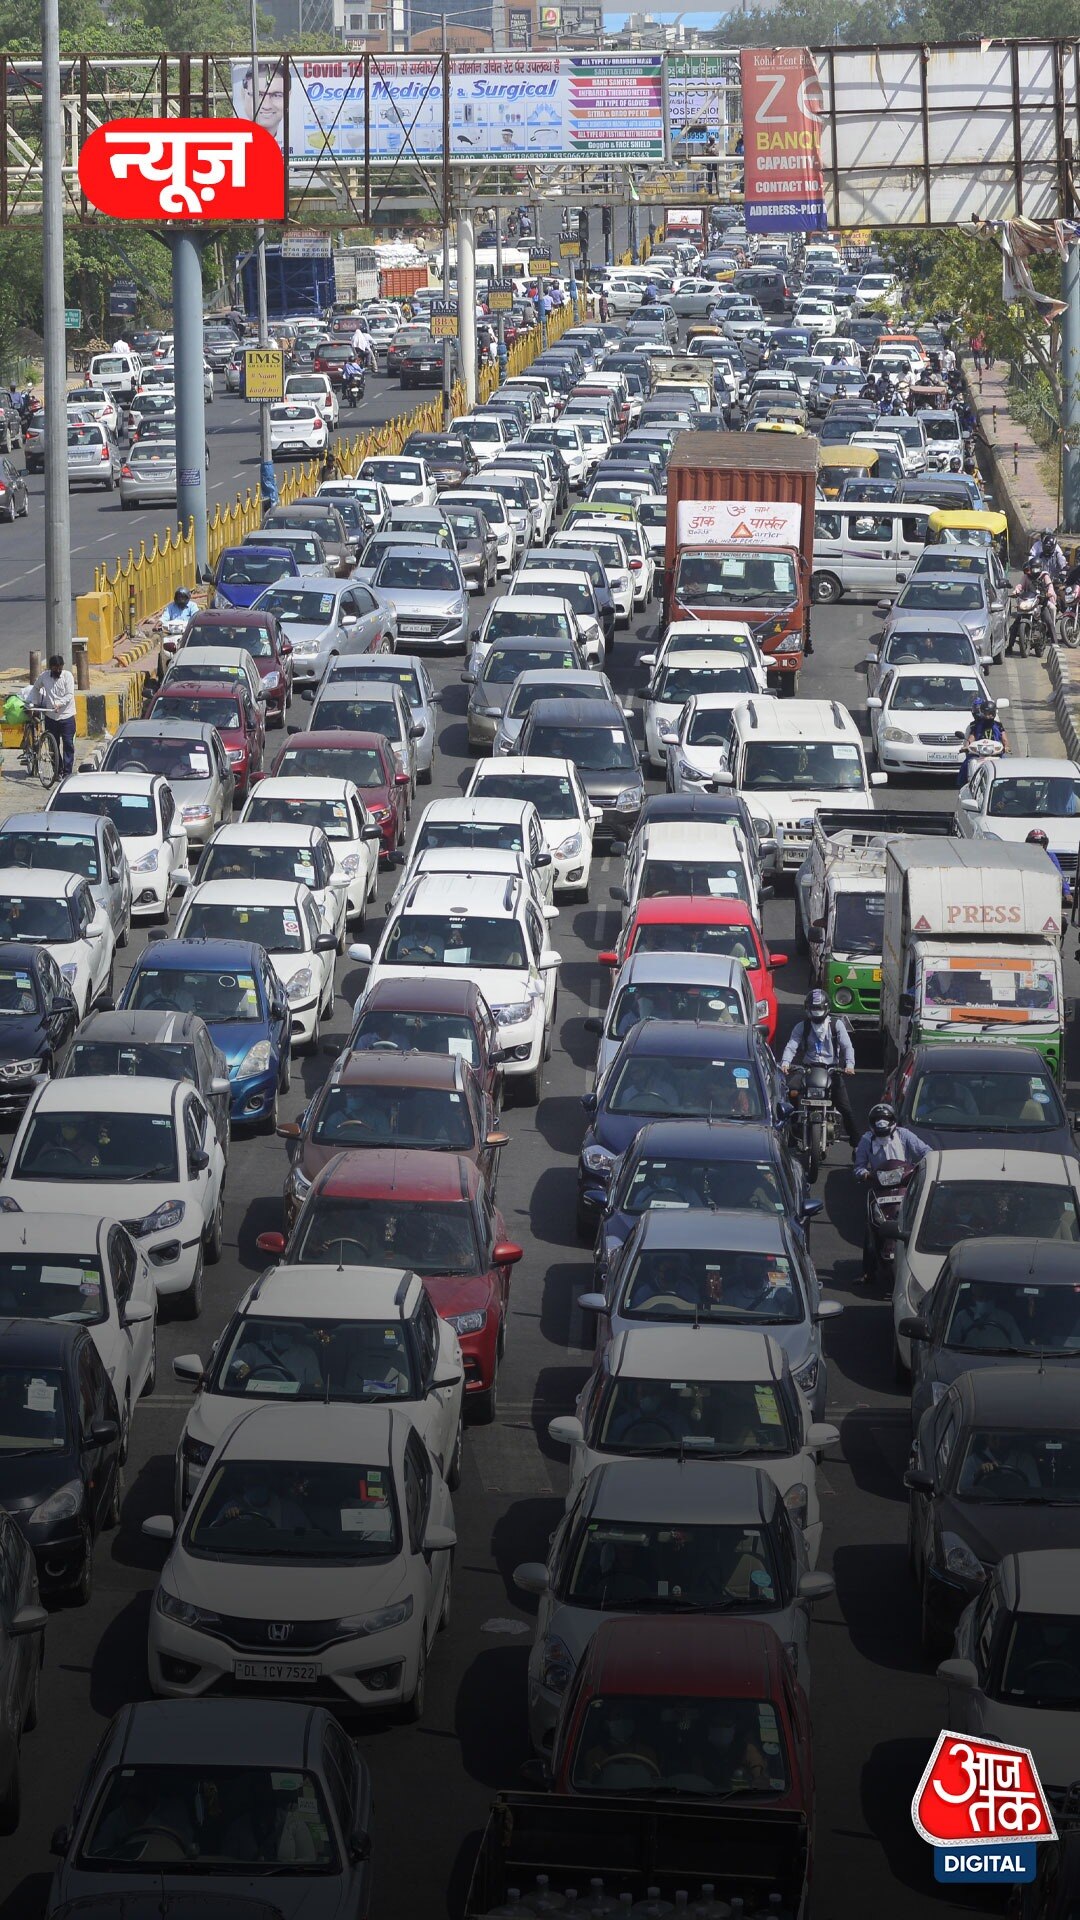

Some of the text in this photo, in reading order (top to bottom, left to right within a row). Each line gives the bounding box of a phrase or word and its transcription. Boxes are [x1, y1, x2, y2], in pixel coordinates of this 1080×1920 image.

[754, 56, 775, 66] Kohli
[777, 55, 797, 66] Tent
[303, 61, 363, 79] Covid-19
[484, 60, 500, 74] उचित
[504, 59, 513, 74] रेट
[526, 61, 551, 74] उपलब्ध
[306, 82, 366, 100] Oscar
[457, 88, 466, 97] &
[471, 79, 559, 100] Surgical
[604, 99, 619, 107] TYPE
[619, 99, 627, 107] OF
[627, 99, 649, 107] GLOVES
[755, 181, 803, 193] CONTACT
[432, 301, 457, 310] IMS
[249, 353, 281, 364] IMS
[688, 516, 788, 530] डाक पार्सल
[947, 905, 1021, 924] PRESS
[244, 1665, 315, 1679] DL 1CV 7522
